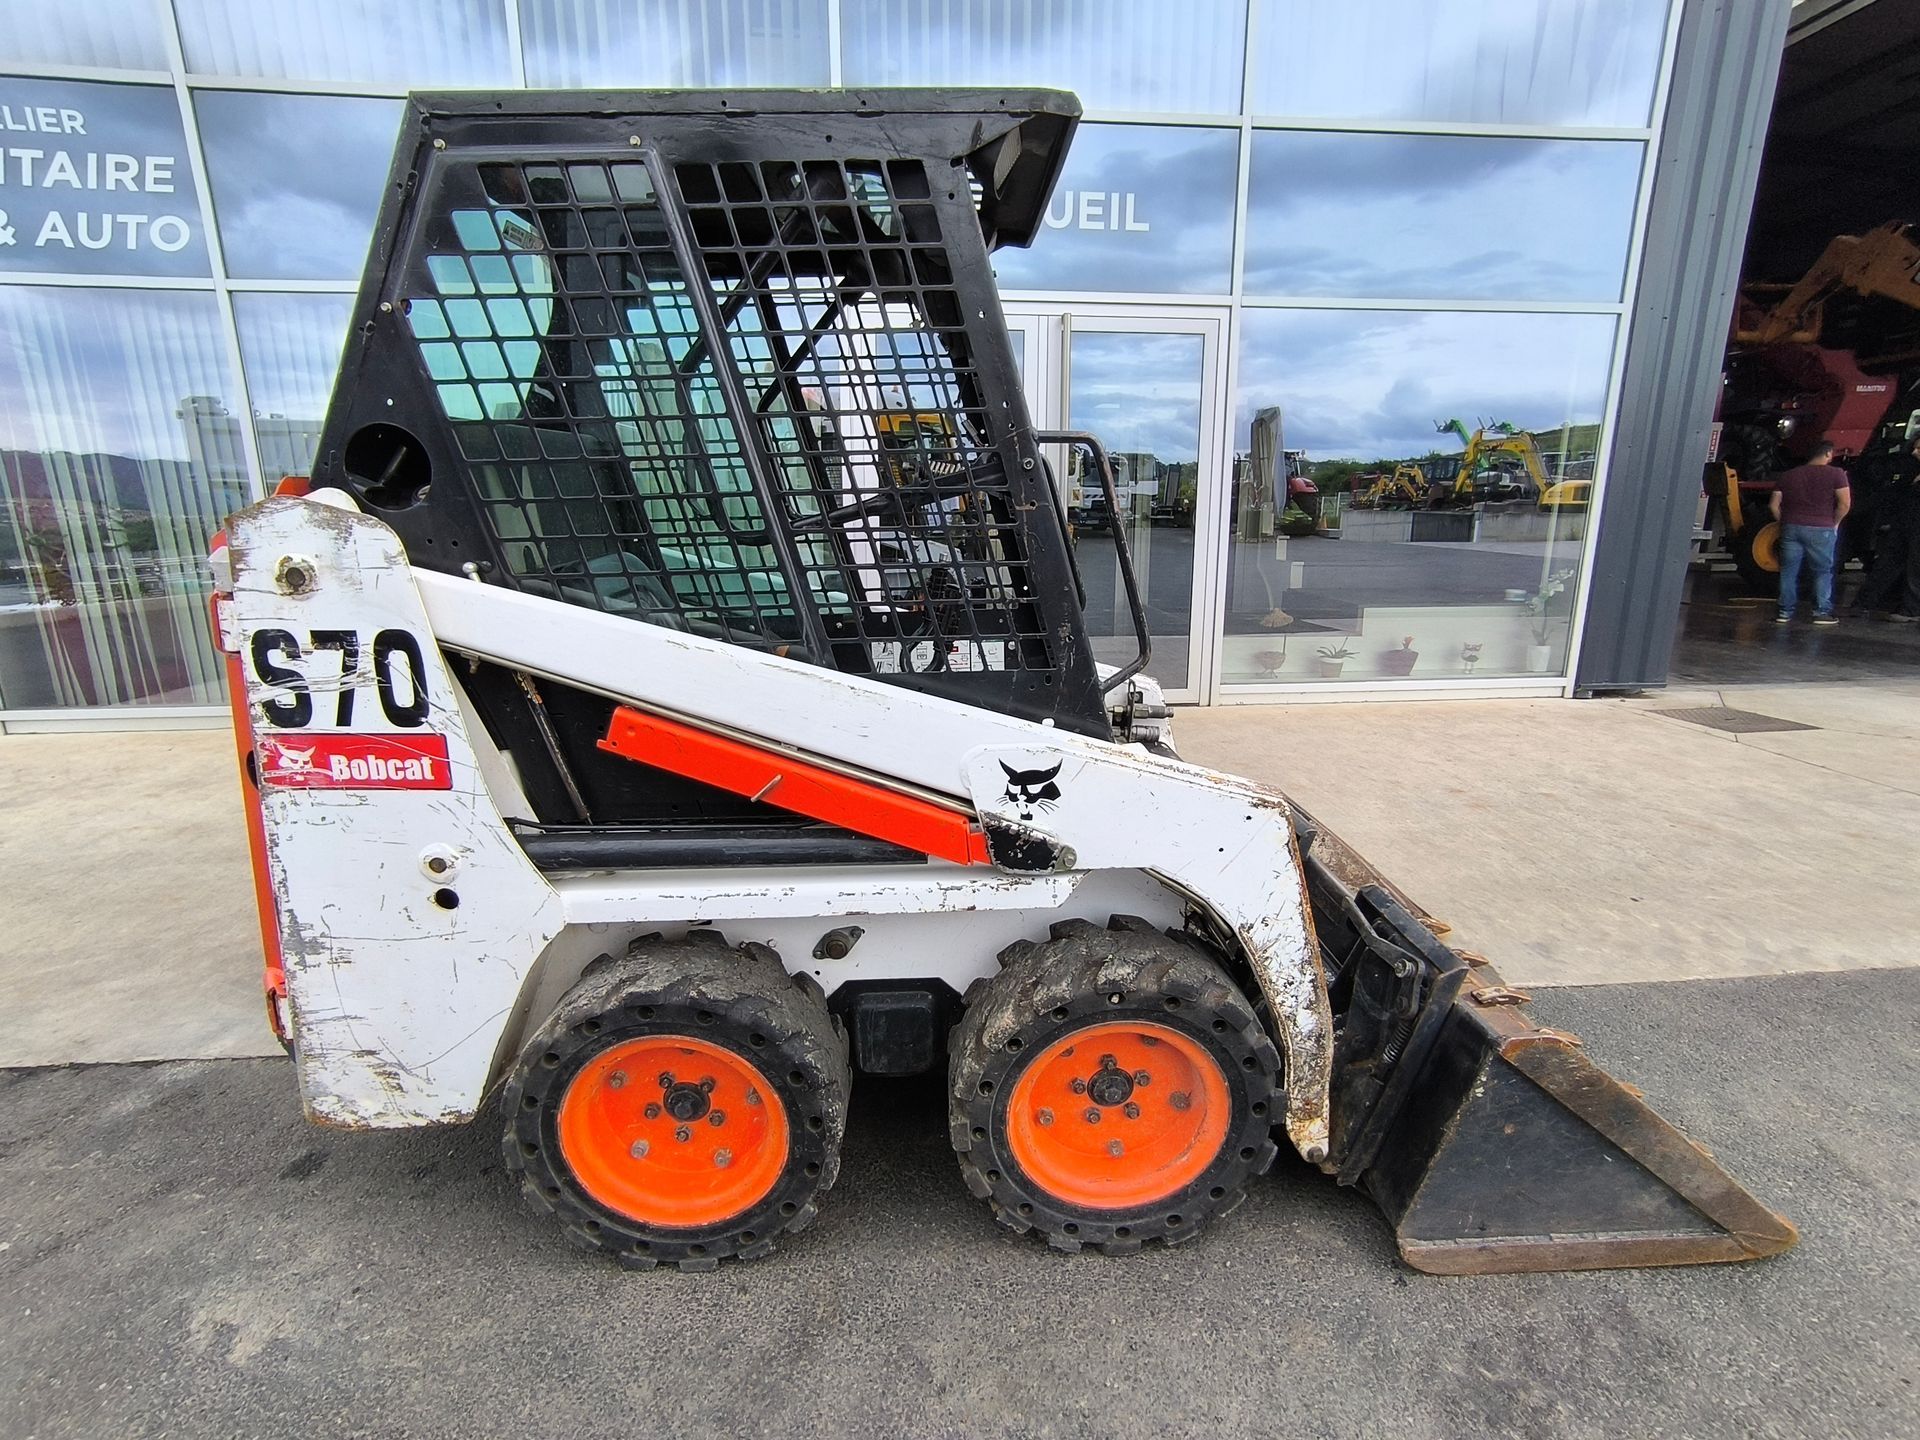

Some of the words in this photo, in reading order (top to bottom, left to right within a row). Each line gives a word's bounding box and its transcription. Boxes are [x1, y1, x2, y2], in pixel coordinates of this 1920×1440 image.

[0, 105, 87, 135] LIER
[34, 210, 191, 252] AUTO
[250, 628, 430, 728] S70
[329, 754, 435, 782] Bobcat
